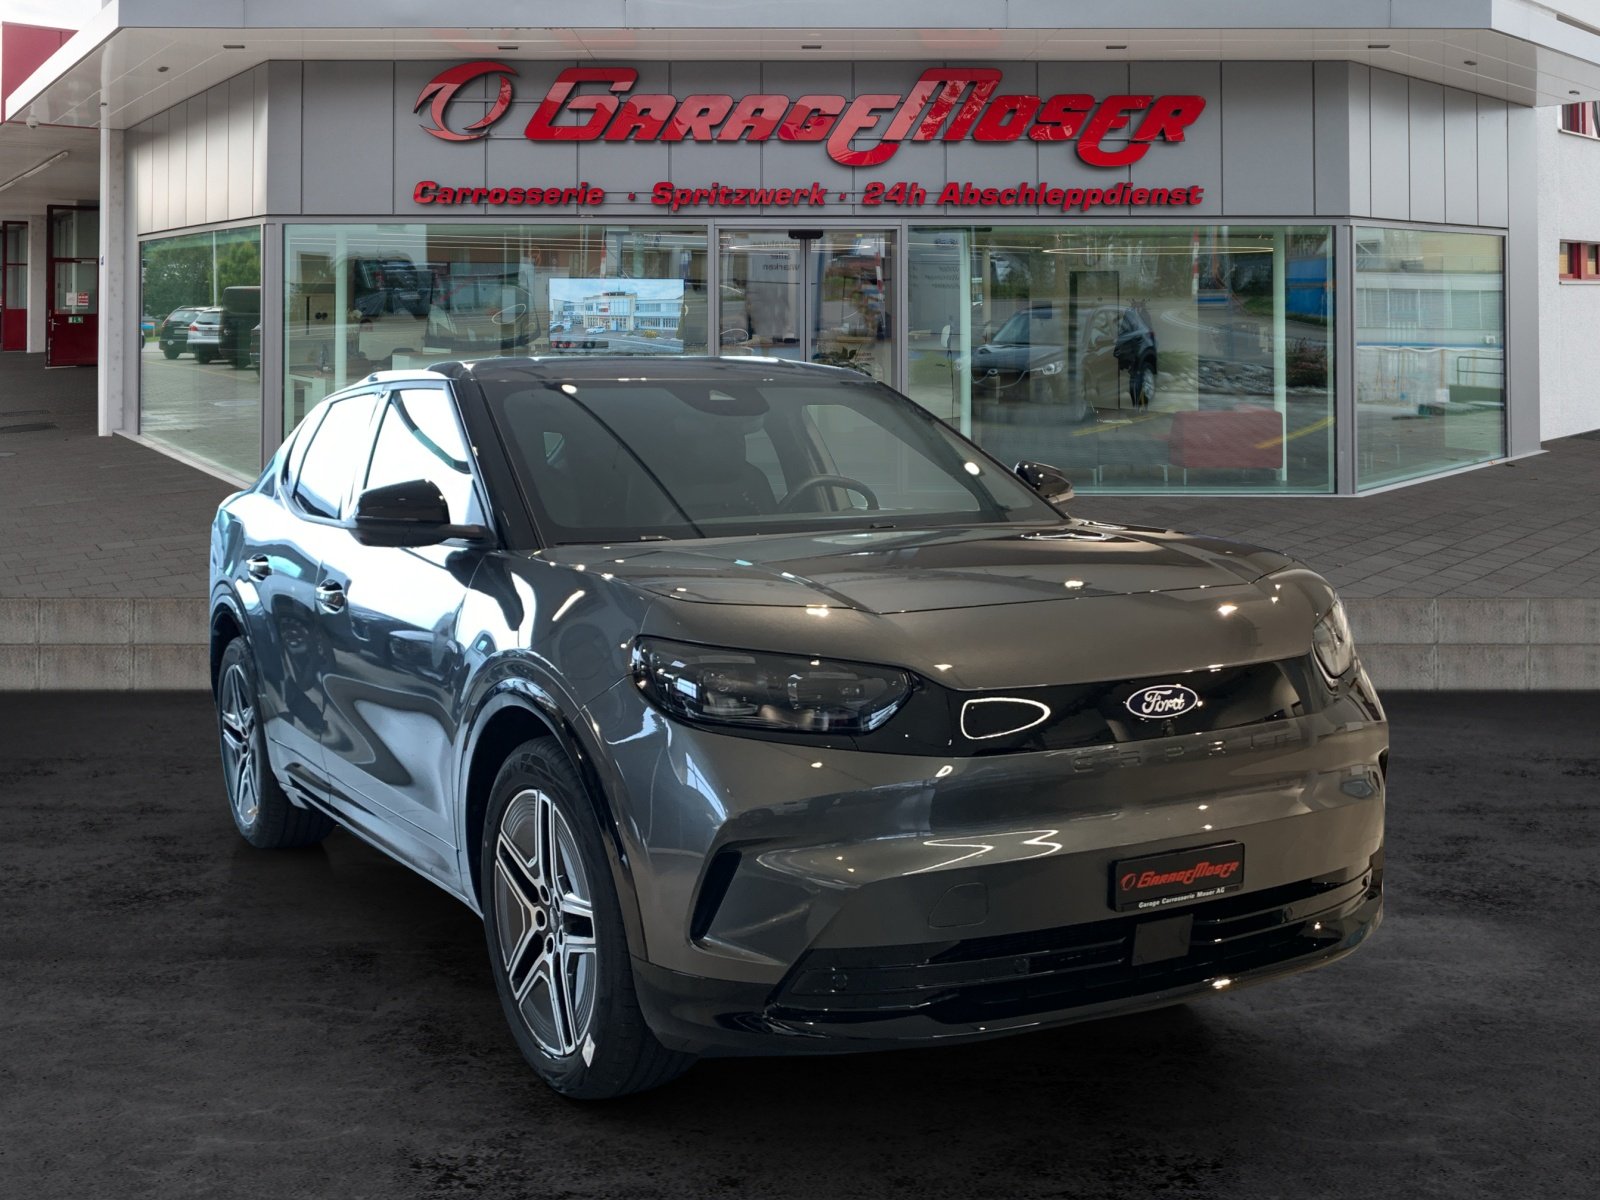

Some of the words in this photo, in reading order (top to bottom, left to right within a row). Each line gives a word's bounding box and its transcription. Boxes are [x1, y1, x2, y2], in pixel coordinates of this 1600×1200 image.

[412, 180, 605, 206] Carrosserie
[651, 181, 826, 211] Spritzwerk
[863, 181, 927, 206] 24h
[937, 181, 1204, 212] Abschleppdienst
[1142, 690, 1185, 714] Ford
[1138, 900, 1160, 909] Garage
[1161, 893, 1195, 905] Carrosserie
[1215, 886, 1225, 894] AG
